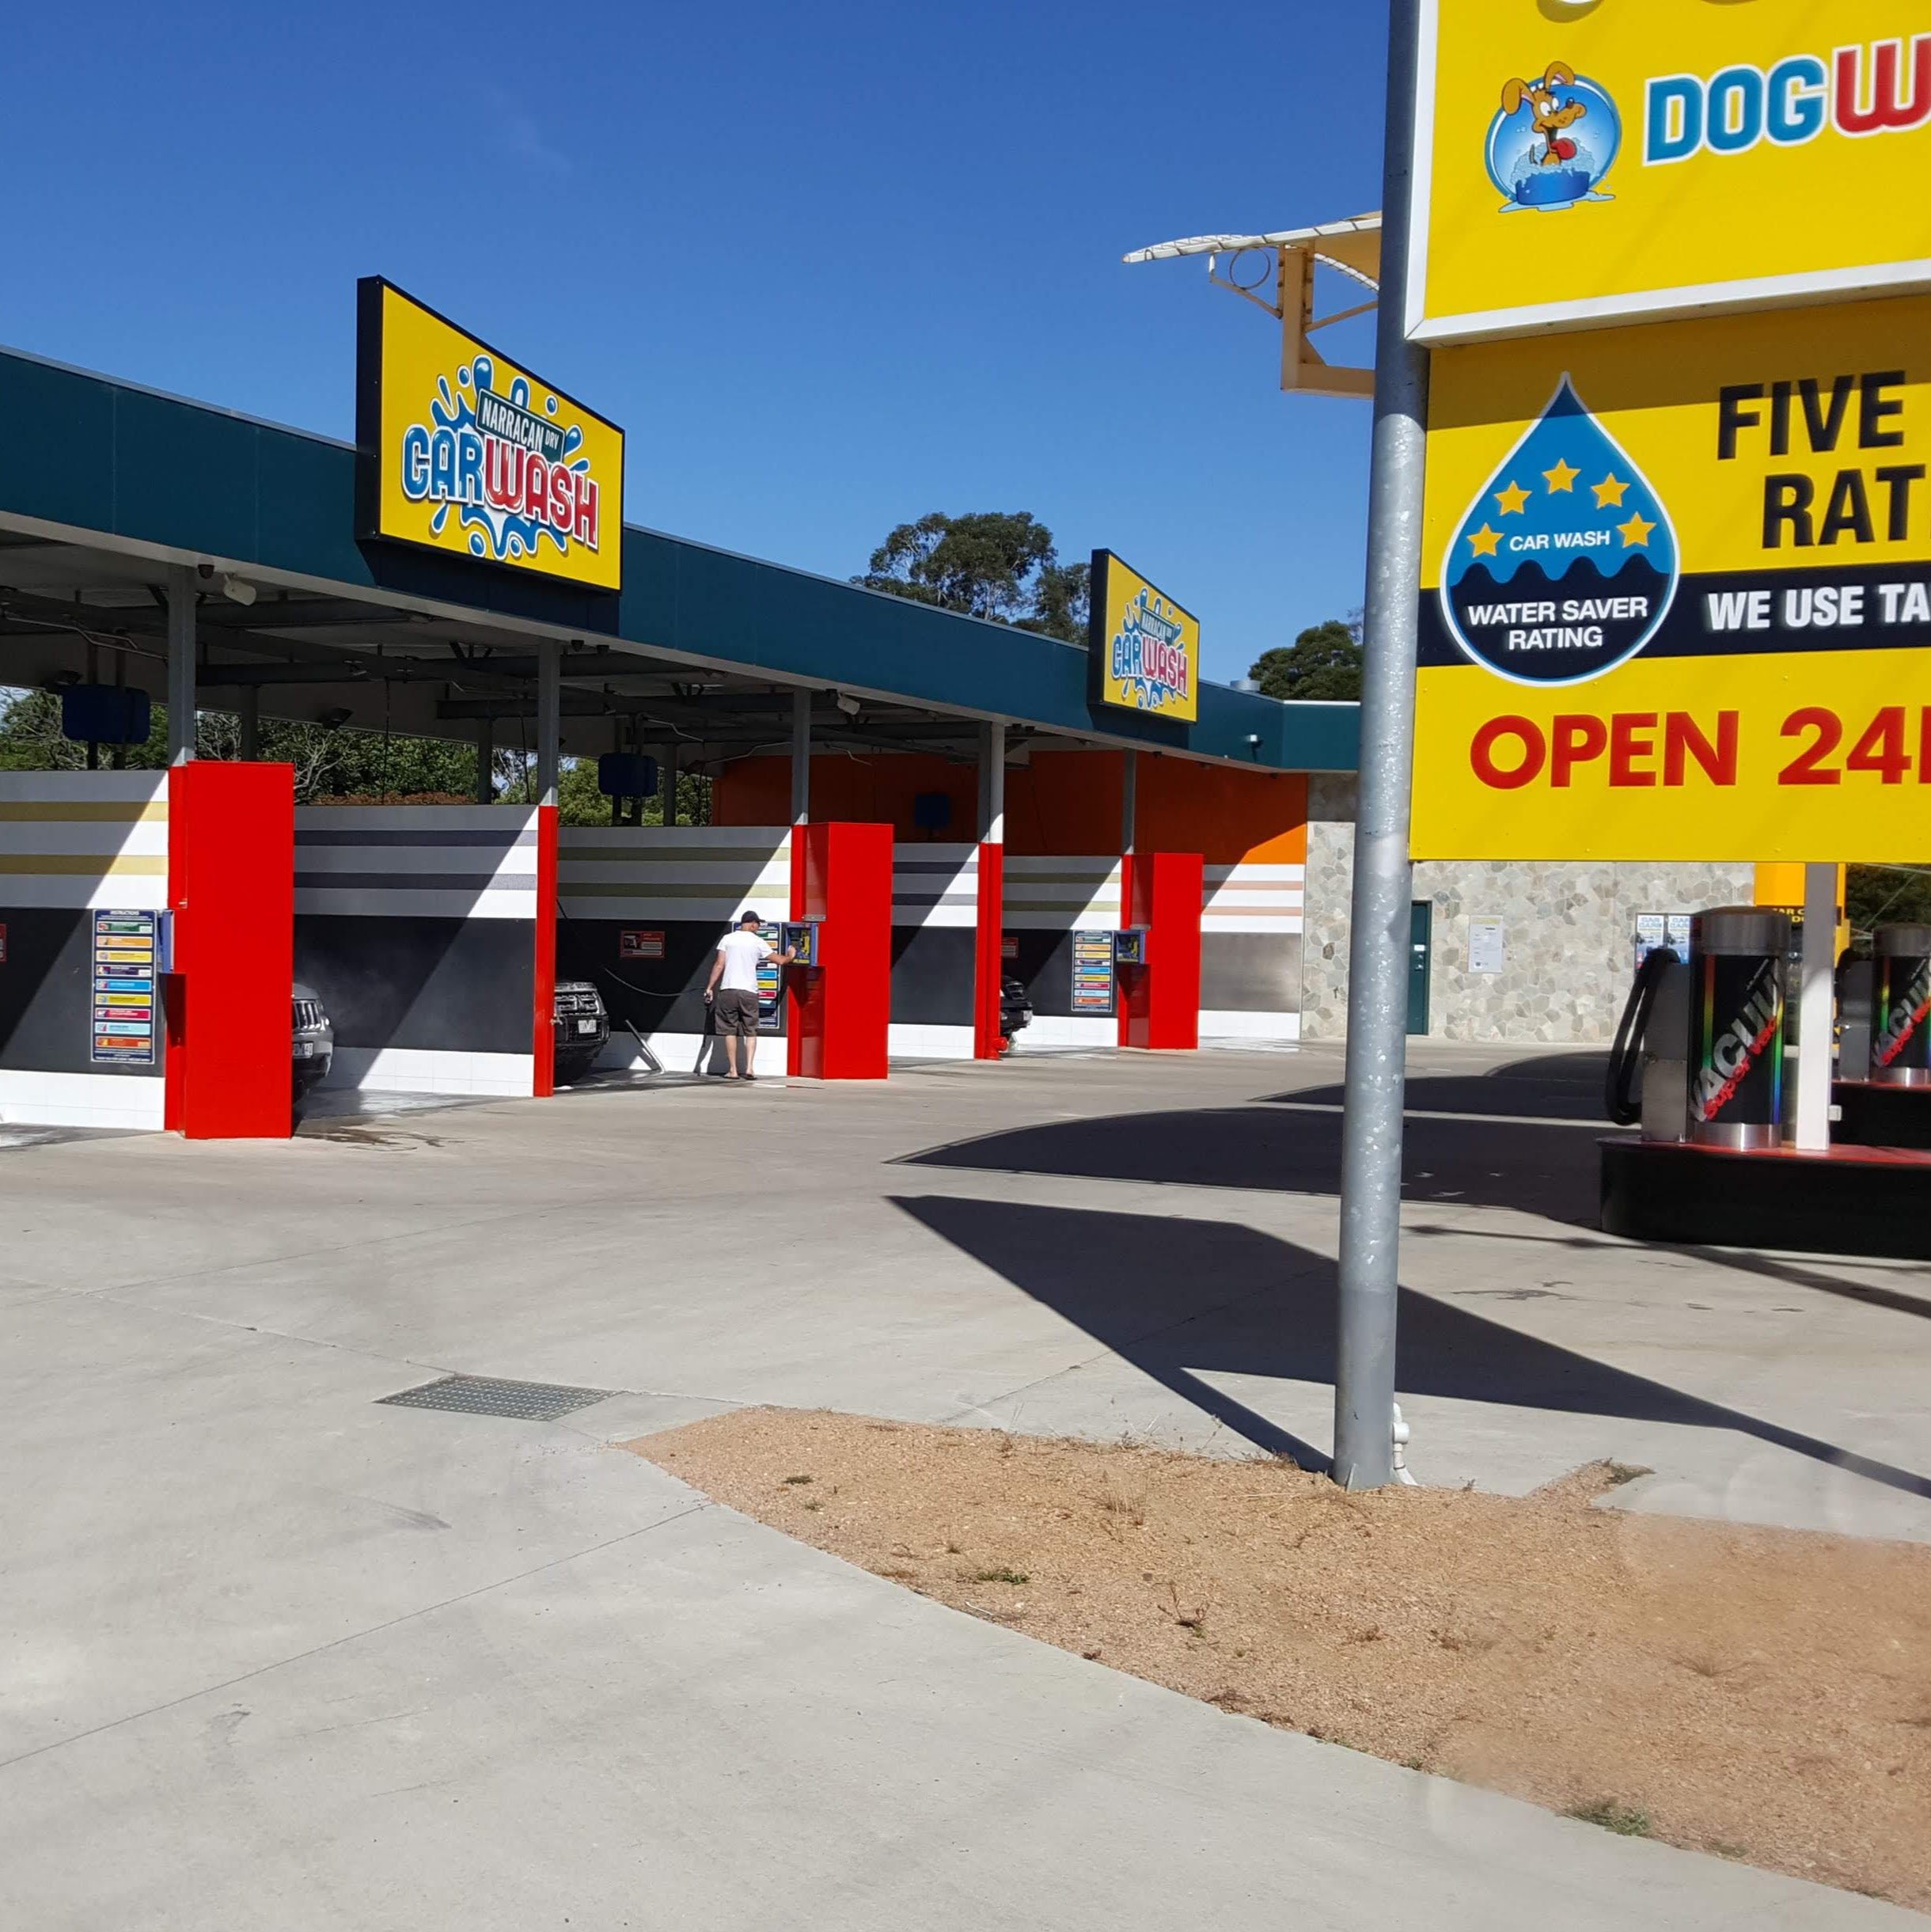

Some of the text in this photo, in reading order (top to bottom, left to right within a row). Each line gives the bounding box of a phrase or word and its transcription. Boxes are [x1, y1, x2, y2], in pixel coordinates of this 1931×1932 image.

[1642, 32, 1931, 166] DOGW
[482, 397, 544, 452] NARRACAN
[1717, 370, 1905, 460] FIVE
[403, 424, 599, 549] CARWASH
[1762, 464, 1925, 548] RAT
[1509, 530, 1610, 551] CAR WASH
[1468, 597, 1648, 625] WATER SAVER
[1509, 626, 1603, 650] RATING
[1709, 583, 1931, 630] WE USE TA
[1112, 633, 1188, 698] CARWASH
[1470, 706, 1931, 790] OPEN 24
